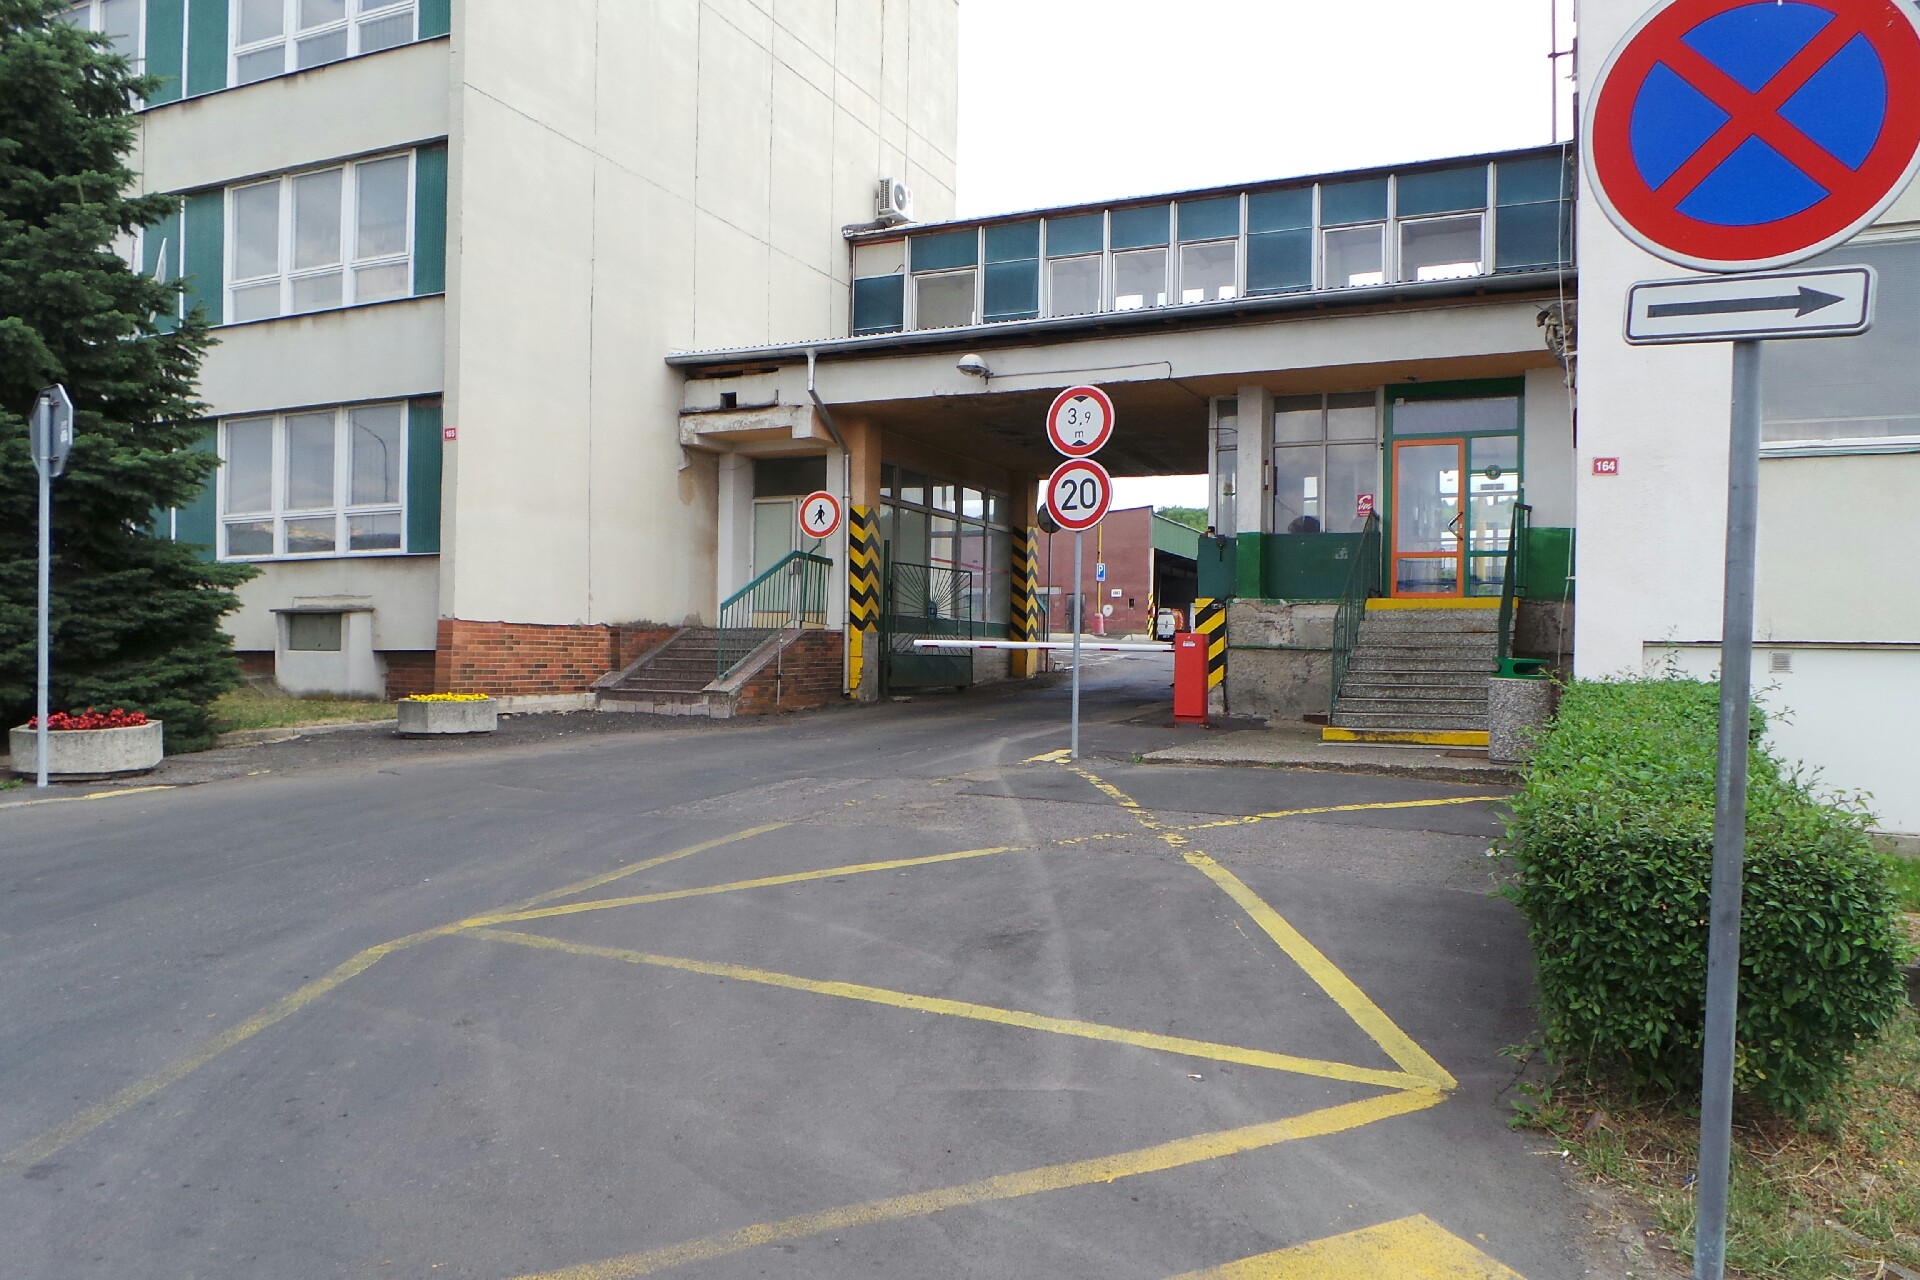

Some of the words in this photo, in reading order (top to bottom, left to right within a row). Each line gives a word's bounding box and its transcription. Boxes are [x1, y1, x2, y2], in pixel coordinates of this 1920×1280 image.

[1067, 407, 1091, 426] 3,9
[1075, 430, 1084, 438] m
[1596, 460, 1615, 472] 164
[1061, 477, 1096, 511] 20
[1098, 565, 1104, 576] P
